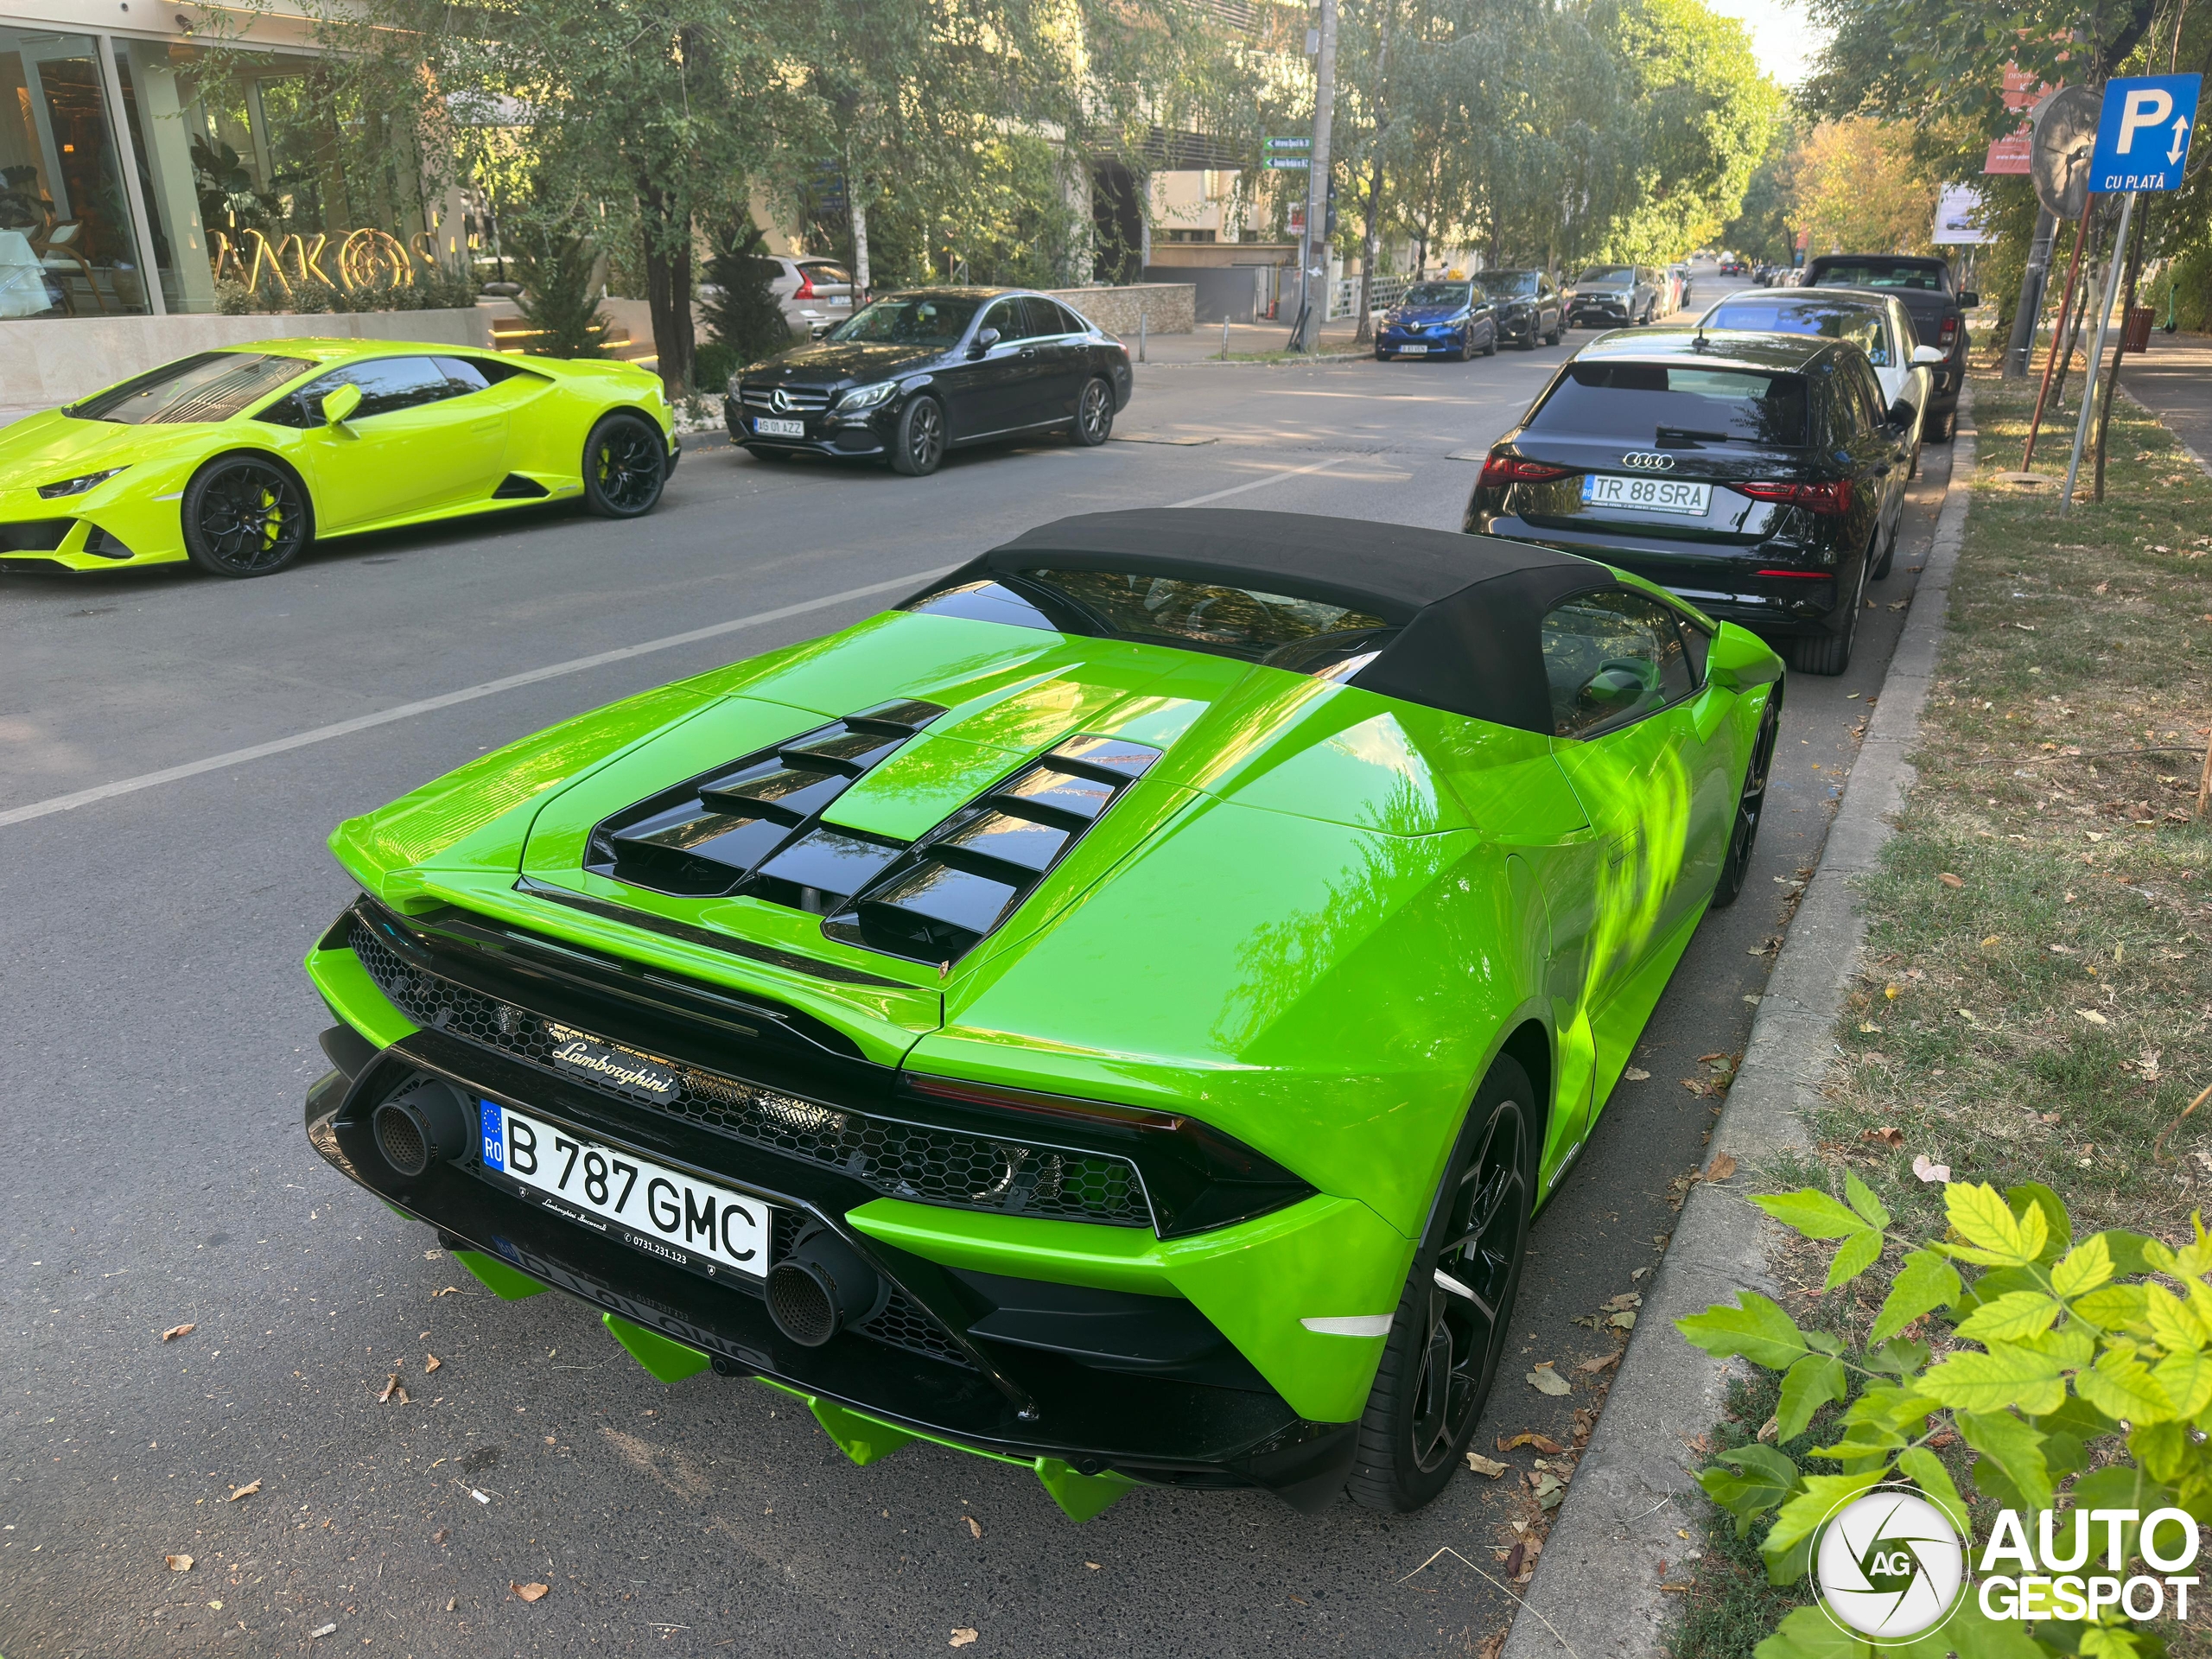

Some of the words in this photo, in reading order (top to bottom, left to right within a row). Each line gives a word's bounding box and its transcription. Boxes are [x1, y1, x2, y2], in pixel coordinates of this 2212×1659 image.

[2116, 88, 2173, 155] P
[2105, 175, 2122, 189] CU
[2125, 172, 2164, 189] PLATĂ
[783, 422, 802, 434] AZZ
[1582, 488, 1592, 498] RO
[1597, 479, 1623, 499] TR
[1630, 481, 1656, 502] 88
[1658, 483, 1701, 506] SRA
[551, 1042, 674, 1093] Lamborghini
[484, 1137, 502, 1163] RO
[507, 1116, 538, 1176] B
[555, 1136, 639, 1214] 787
[647, 1176, 757, 1262] GMC
[542, 1198, 577, 1219] Lamborghini
[633, 1236, 688, 1265] 0731.231.123
